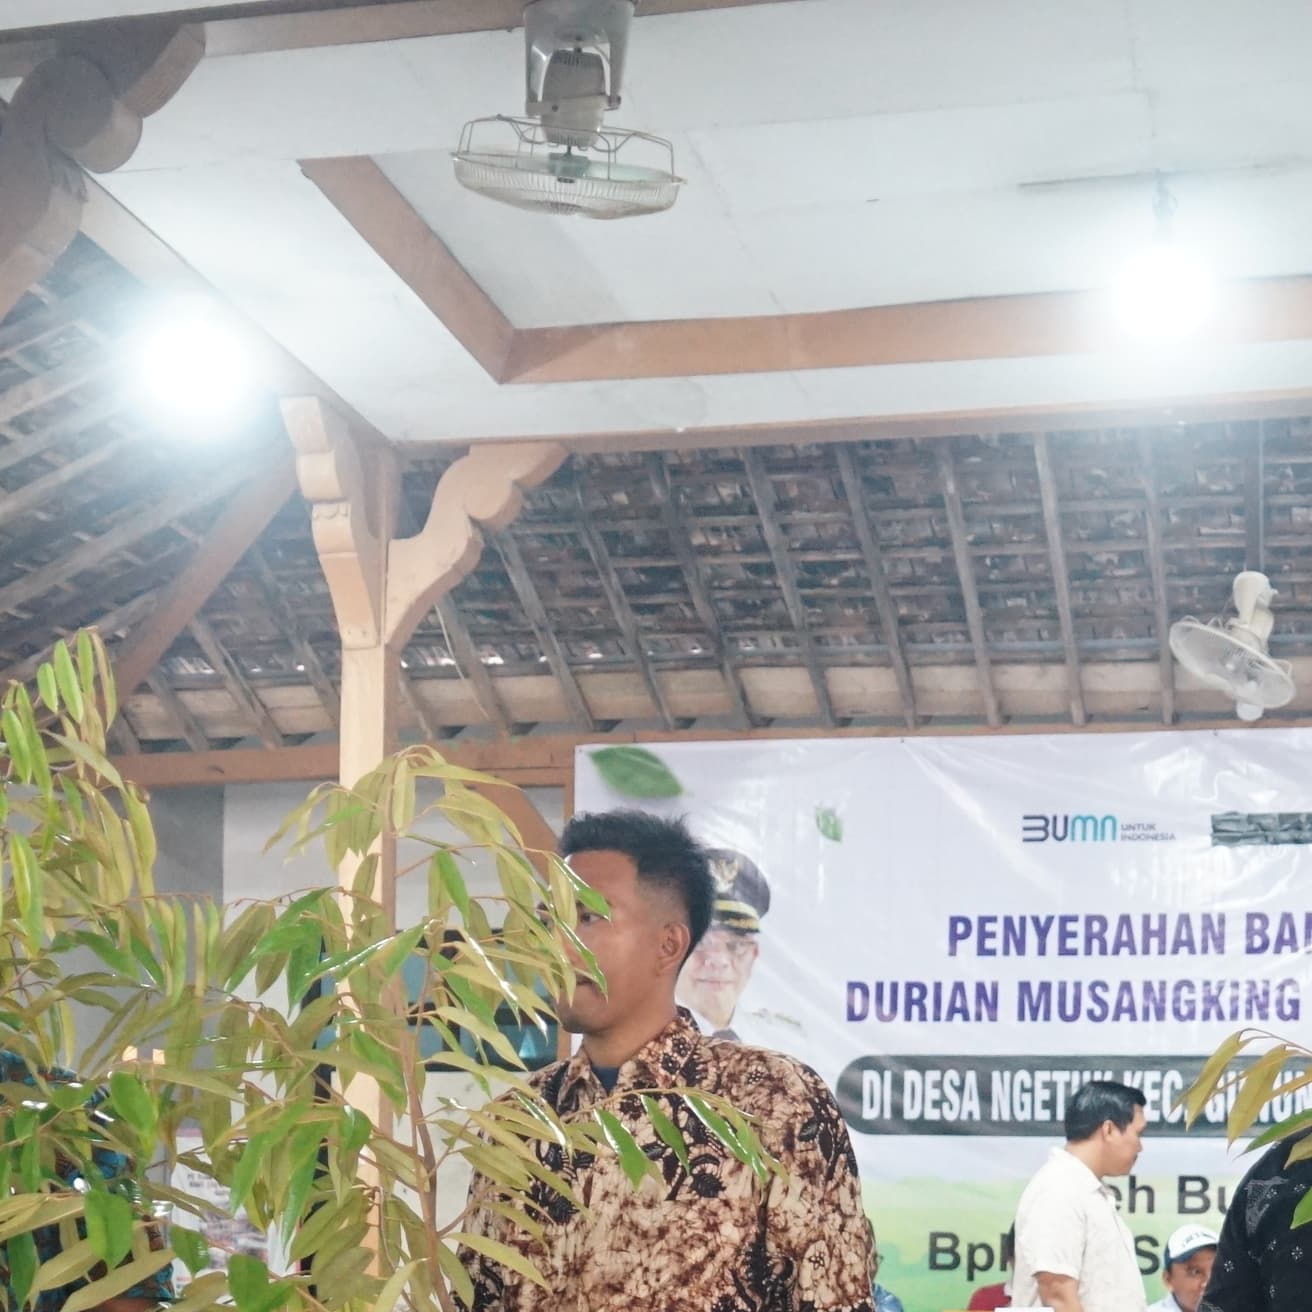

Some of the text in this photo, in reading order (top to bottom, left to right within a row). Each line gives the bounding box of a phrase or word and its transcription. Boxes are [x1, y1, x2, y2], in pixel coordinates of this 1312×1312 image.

[948, 912, 1227, 957] PENYERAHAN
[846, 980, 999, 1023] DURIAN
[1017, 977, 1300, 1023] MUSANGKING
[861, 1069, 892, 1122] DI
[903, 1069, 981, 1122] DESA
[991, 1069, 1113, 1123] NGET
